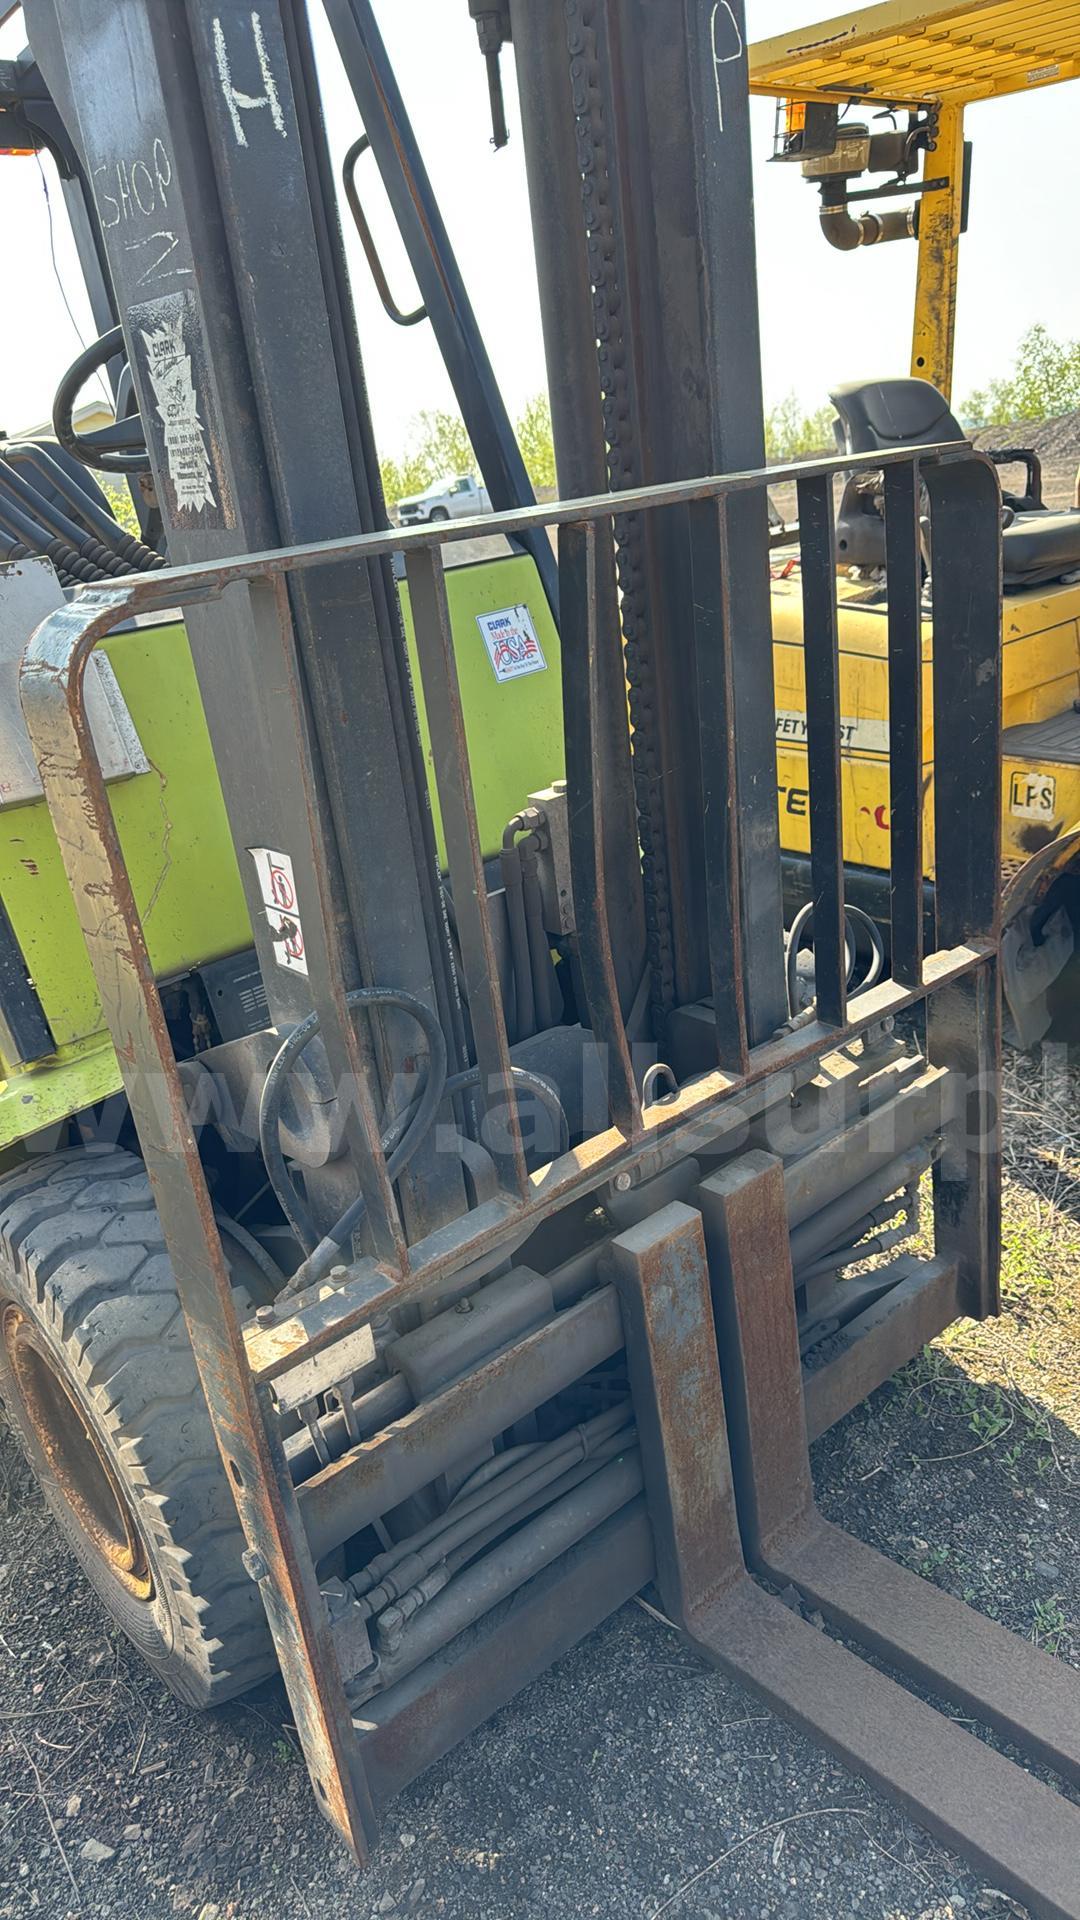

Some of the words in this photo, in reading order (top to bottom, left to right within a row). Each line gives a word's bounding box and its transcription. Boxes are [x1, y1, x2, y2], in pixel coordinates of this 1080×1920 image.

[212, 11, 288, 148] H
[710, 0, 743, 133] P
[94, 138, 171, 228] SHOP
[152, 340, 177, 357] CLARK
[487, 617, 511, 631] CLARK
[493, 634, 534, 666] USA
[776, 717, 808, 735] FETY
